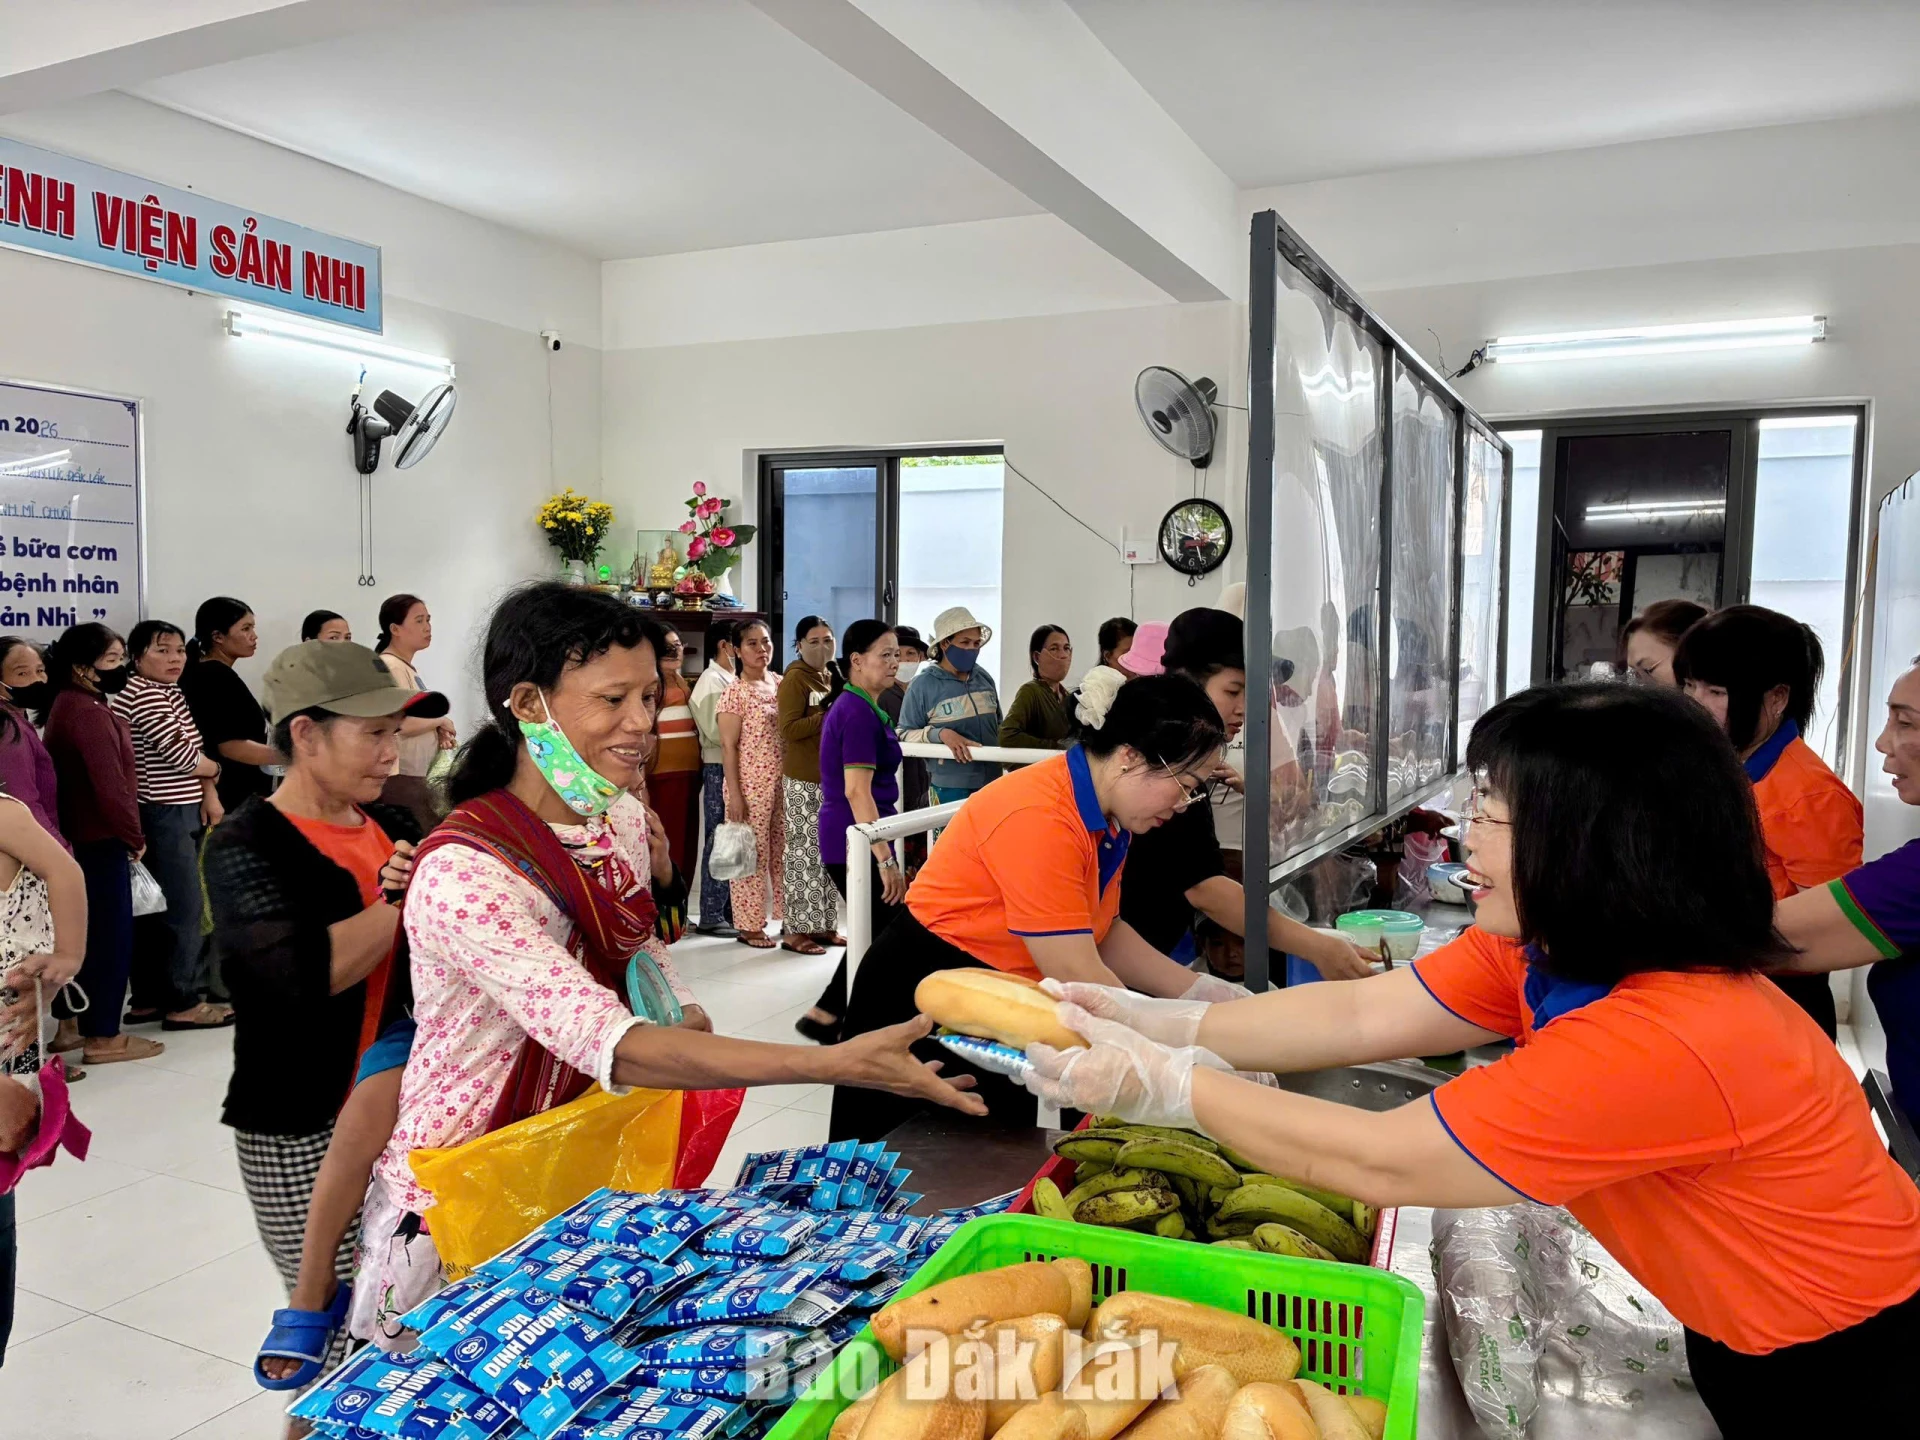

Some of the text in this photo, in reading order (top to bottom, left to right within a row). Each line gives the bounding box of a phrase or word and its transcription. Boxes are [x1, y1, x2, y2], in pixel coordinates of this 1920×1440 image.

[0, 164, 366, 312] NH VIỆN SẢN NHI
[13, 536, 60, 558] bữa
[67, 545, 117, 561] cơm
[0, 571, 119, 598] bệnh nhân
[37, 606, 76, 627] Nhi
[596, 1206, 630, 1229] DINH
[543, 1262, 579, 1281] DINH
[449, 1287, 515, 1332] Vinamilk
[497, 1311, 534, 1340] SỮA
[482, 1339, 527, 1378] DINH
[374, 1387, 417, 1417] DINH
[401, 1361, 448, 1392] DƯỠN
[375, 1369, 411, 1391] SỮA
